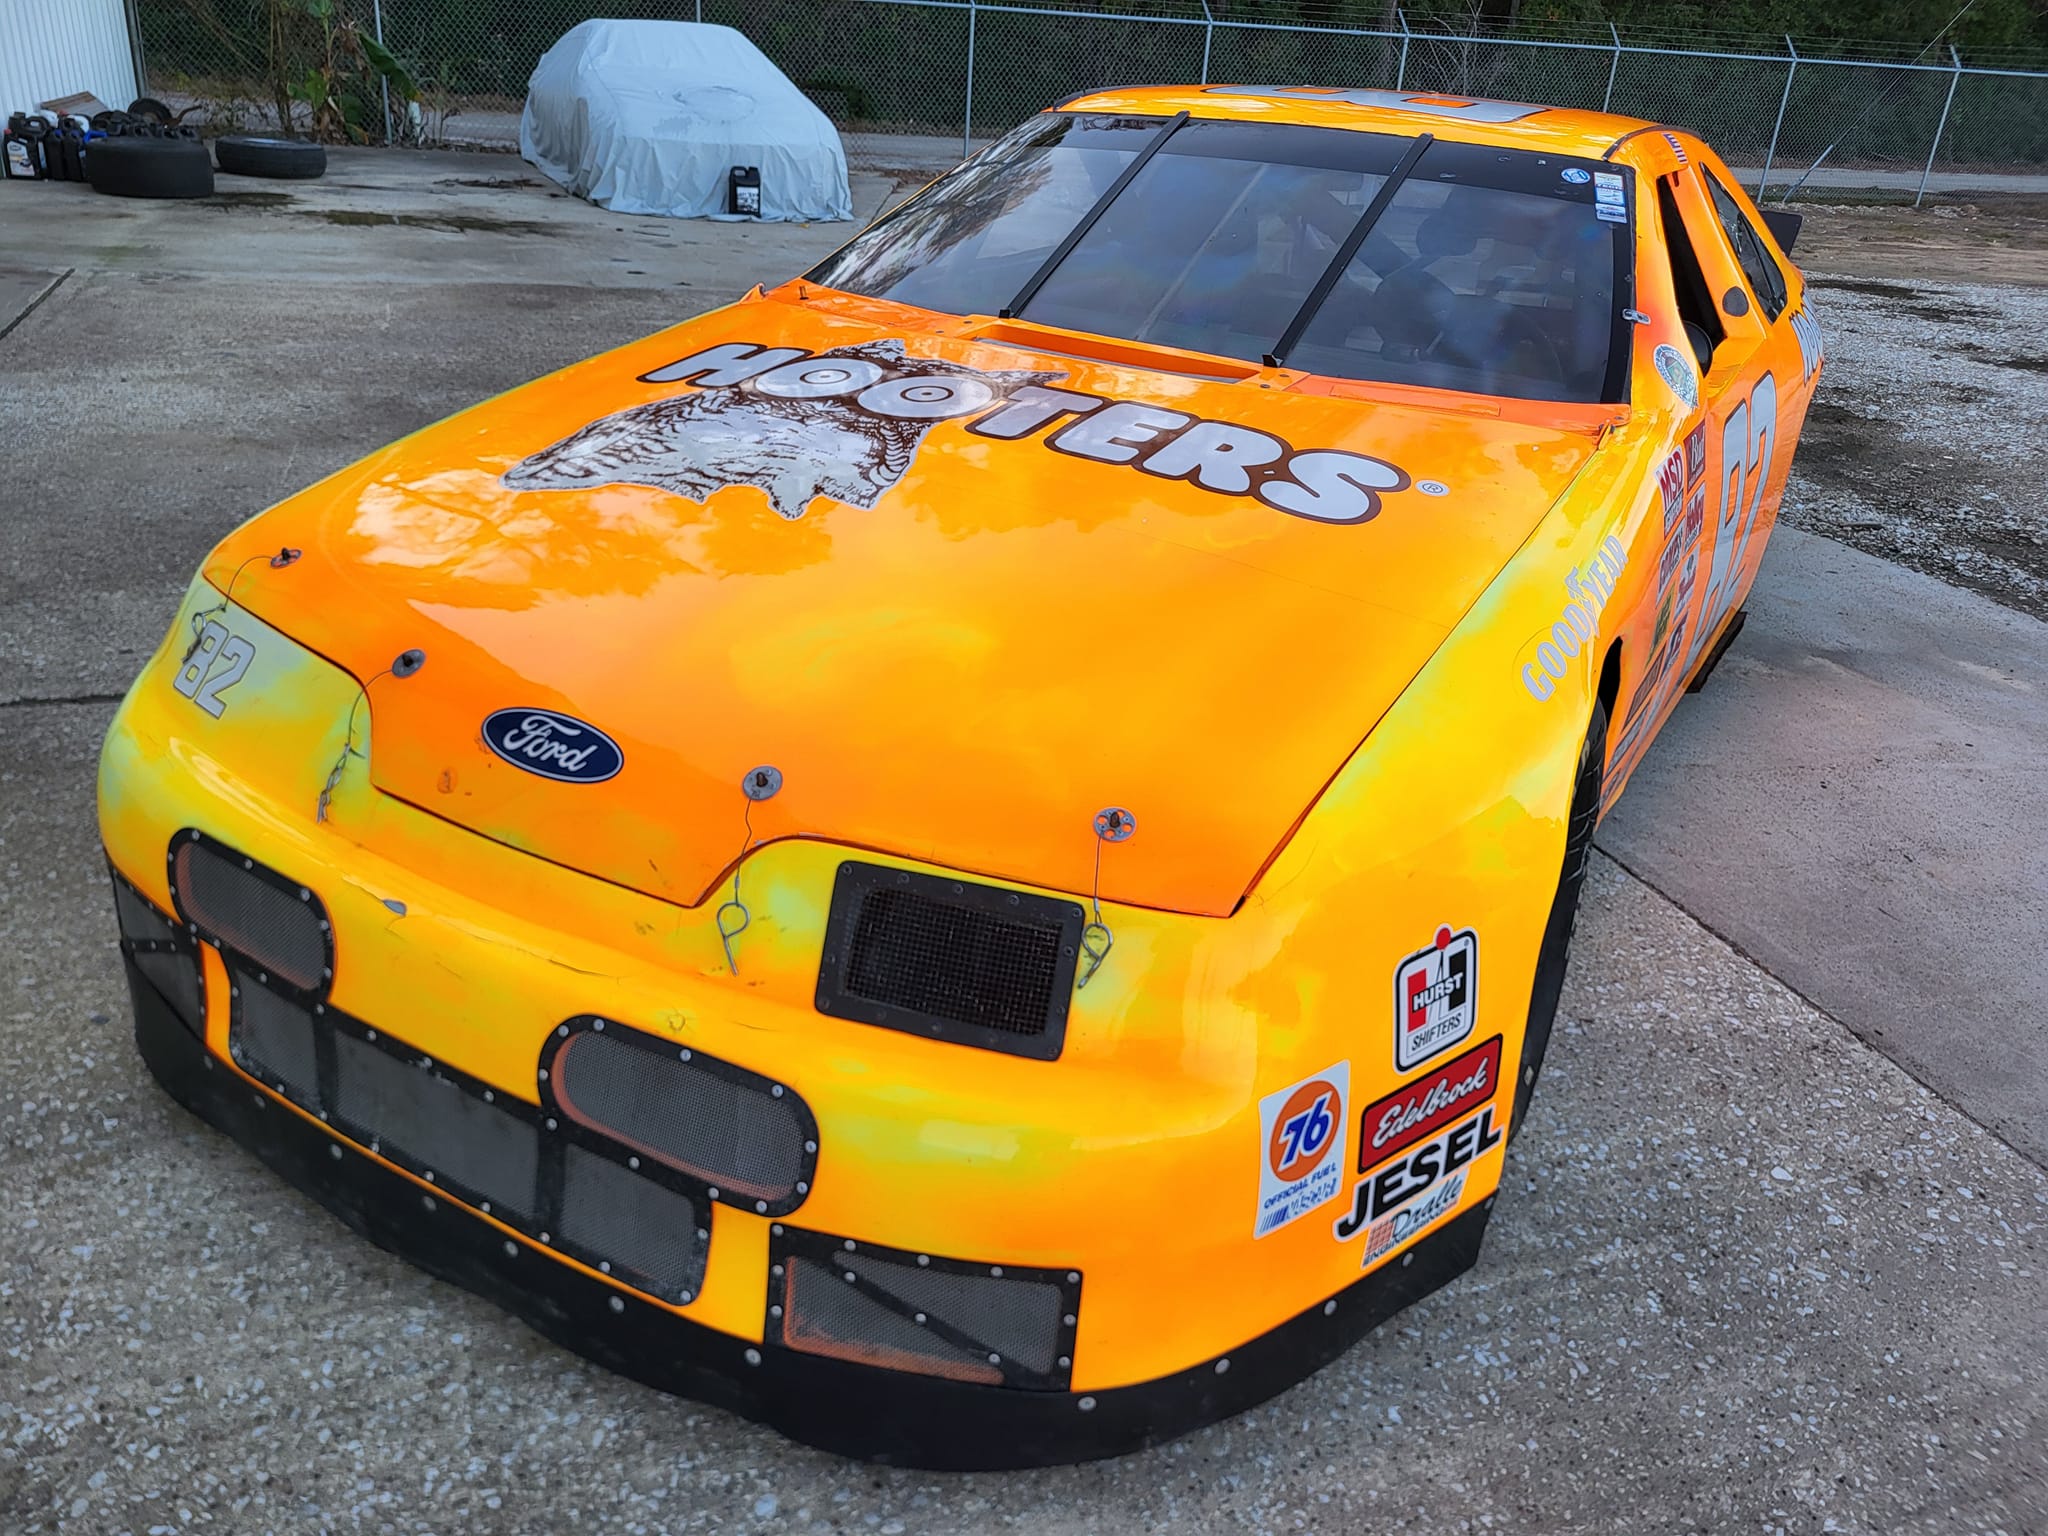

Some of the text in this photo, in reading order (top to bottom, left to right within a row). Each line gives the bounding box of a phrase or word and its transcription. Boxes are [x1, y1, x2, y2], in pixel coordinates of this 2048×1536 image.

[636, 342, 1411, 525] HOOTERS
[1659, 450, 1684, 513] MSD
[1521, 535, 1629, 702] GOODYEAR
[173, 620, 256, 719] 82
[503, 714, 598, 772] Ford
[1412, 972, 1464, 1012] HURST
[1412, 1012, 1462, 1051] SHIFTERS
[1280, 1092, 1332, 1170] 76
[1372, 1057, 1489, 1148] Edelbrock
[1311, 1162, 1336, 1184] FUEL
[1337, 1107, 1501, 1237] JESEL
